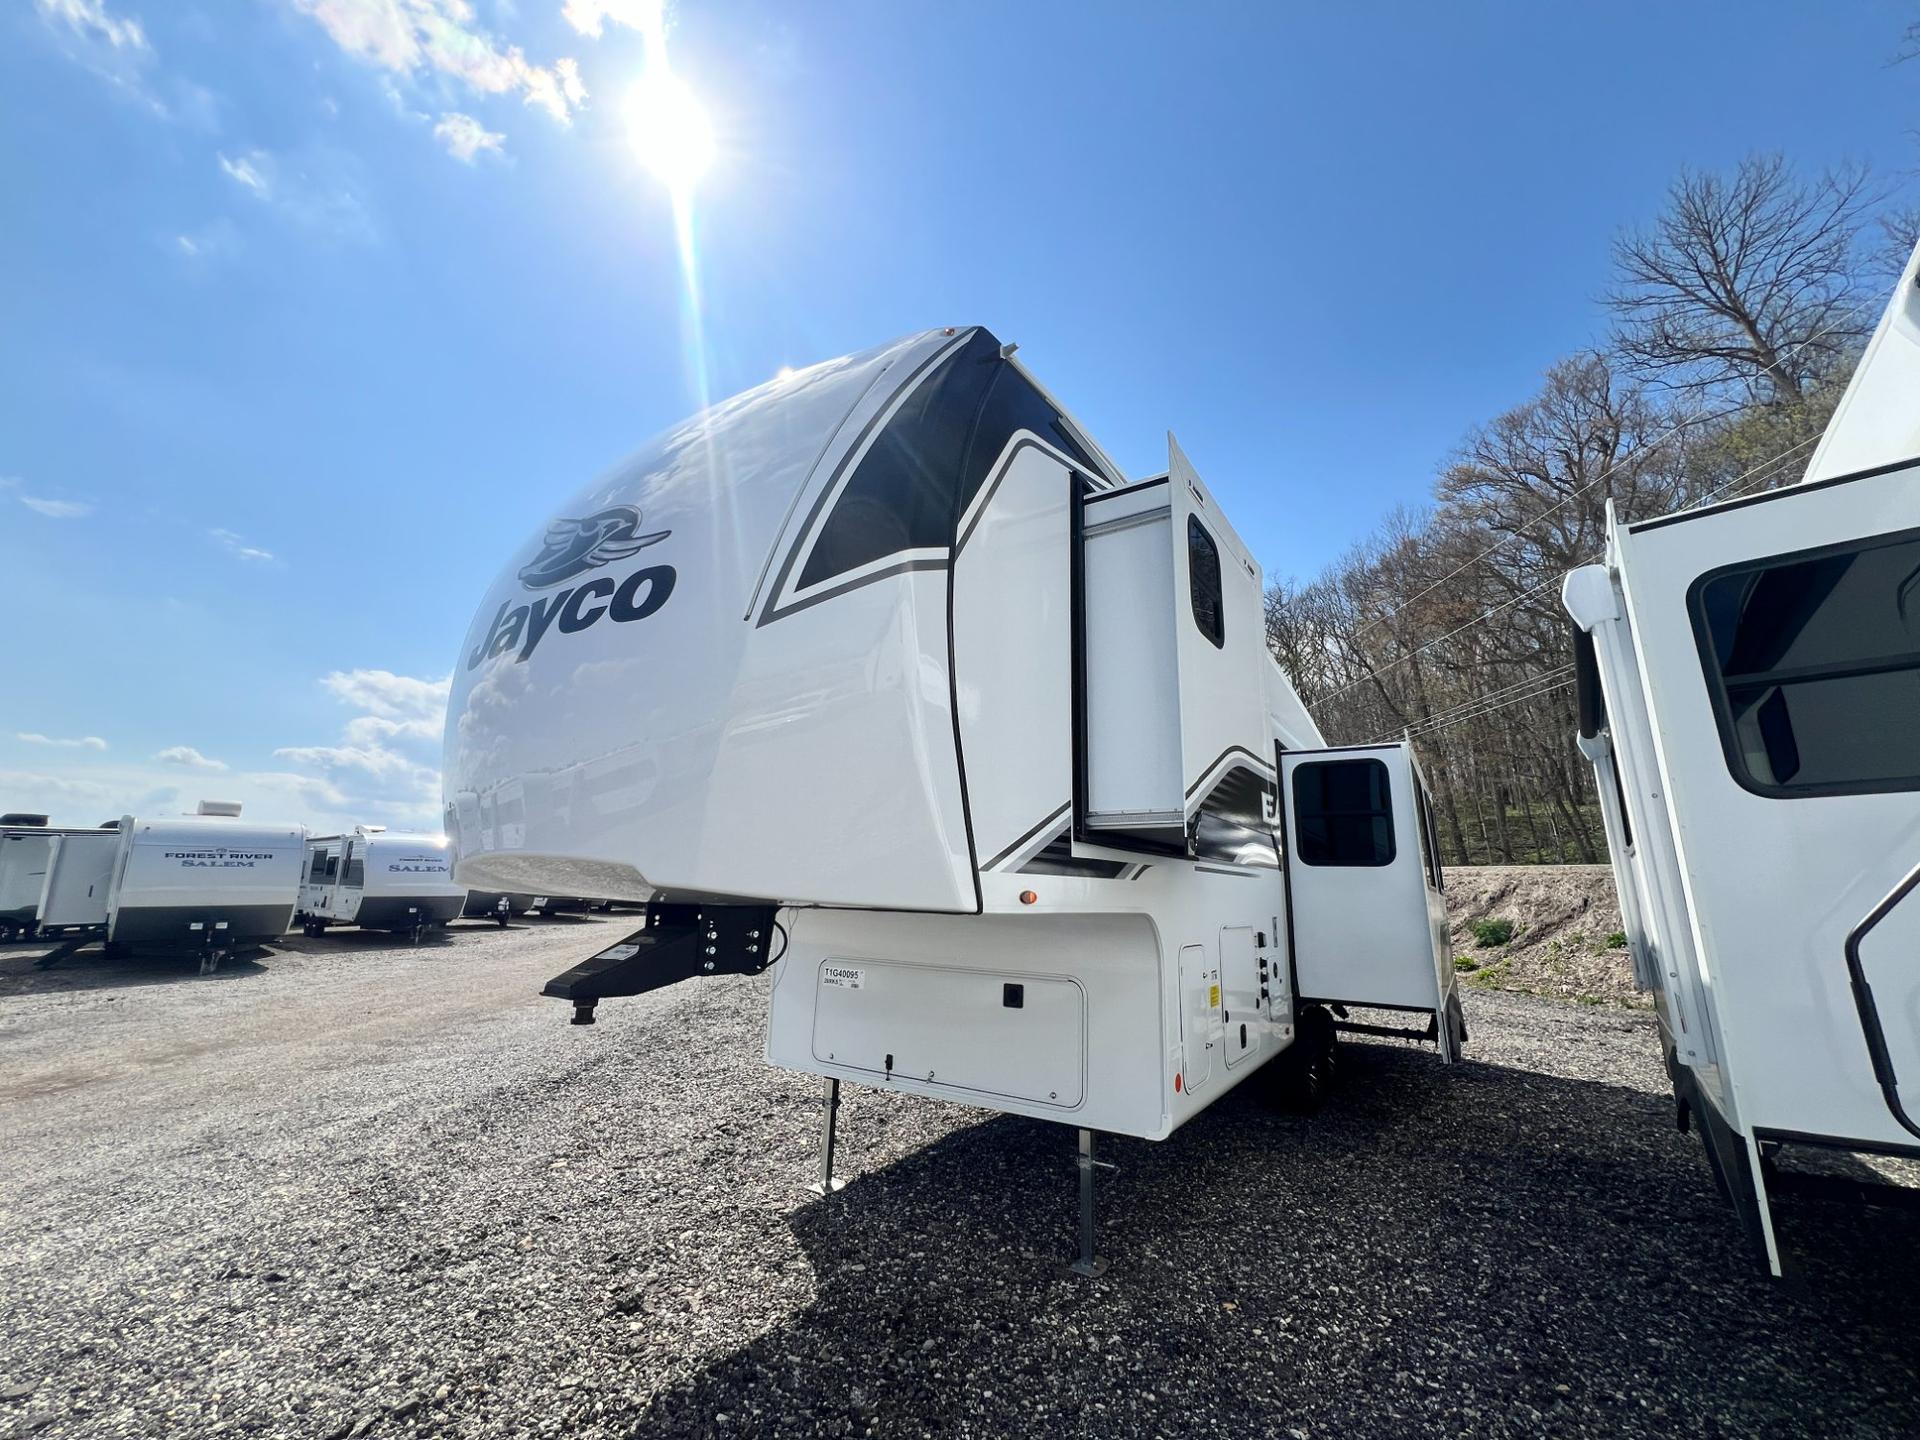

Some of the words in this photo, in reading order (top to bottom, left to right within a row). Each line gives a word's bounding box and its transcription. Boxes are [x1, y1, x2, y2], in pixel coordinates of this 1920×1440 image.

[467, 565, 677, 671] Jayco
[181, 859, 255, 868] SALEM
[825, 968, 859, 979] T1G40095
